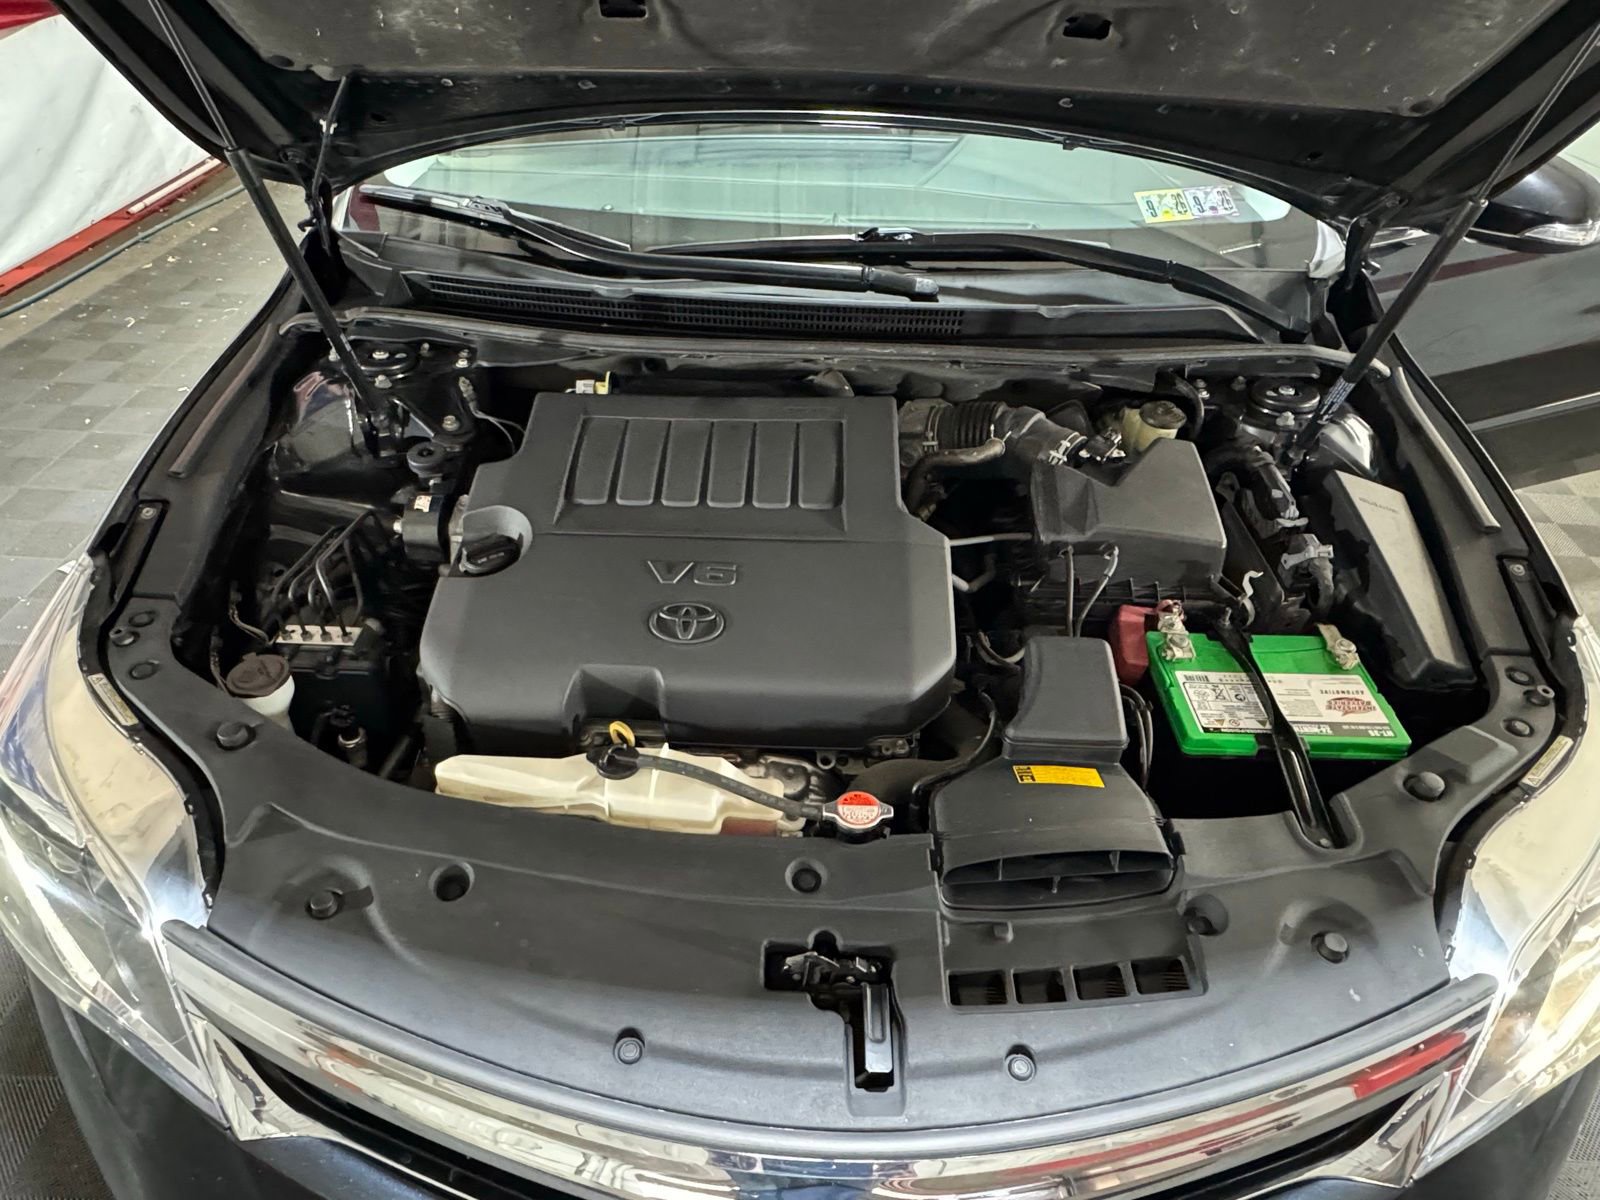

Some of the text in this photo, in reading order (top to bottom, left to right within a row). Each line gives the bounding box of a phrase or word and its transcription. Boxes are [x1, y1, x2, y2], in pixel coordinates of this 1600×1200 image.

[1146, 199, 1158, 217] 9
[1193, 196, 1205, 213] 9
[647, 560, 737, 586] V6
